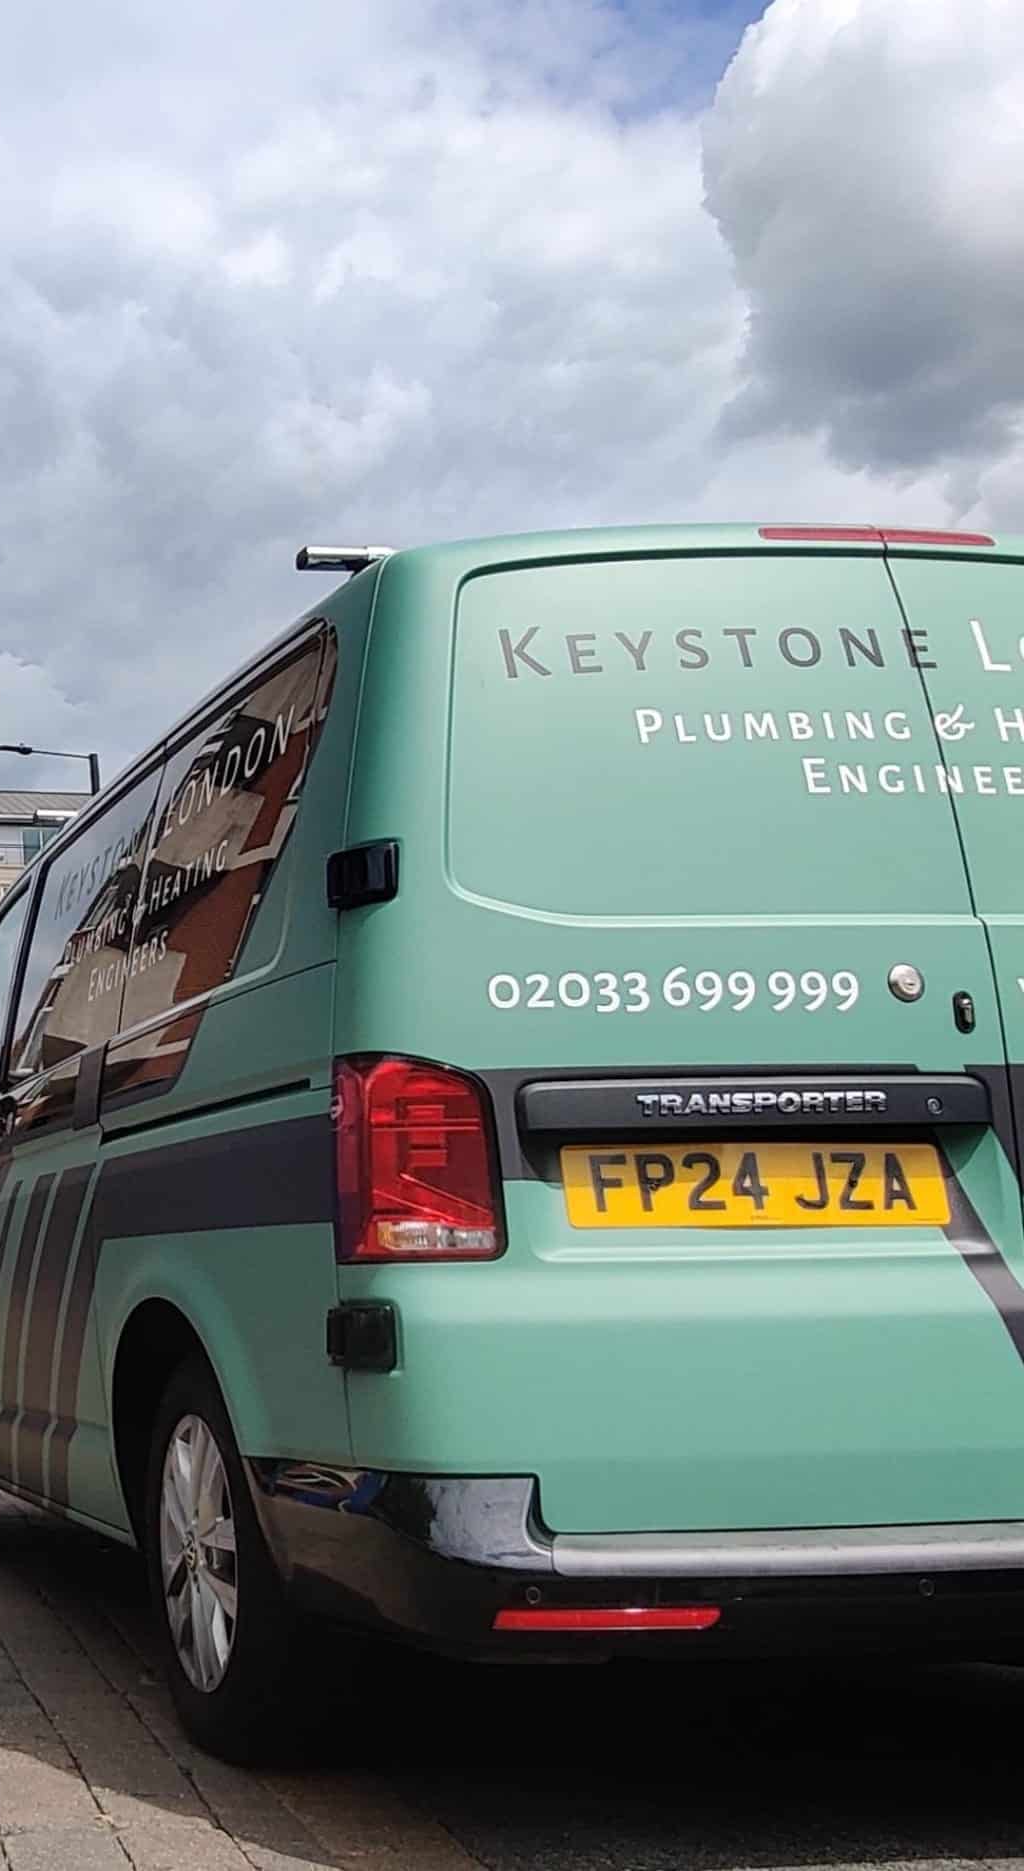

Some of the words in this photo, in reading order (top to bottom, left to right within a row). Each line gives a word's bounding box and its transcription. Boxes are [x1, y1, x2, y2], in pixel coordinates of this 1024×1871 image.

[497, 626, 939, 679] KEYSTONE
[969, 620, 1024, 671] L
[635, 708, 912, 743] PLUMBING
[934, 704, 975, 740] &
[163, 704, 295, 838] LONDON
[802, 758, 1024, 795] ENGINEE
[148, 839, 229, 916] HEATING
[88, 930, 169, 1002] ENGINEERS
[488, 972, 651, 1013] 02033
[662, 966, 756, 1012] 699
[767, 971, 860, 1012] 999
[637, 1091, 887, 1117] TRANSPORTER
[587, 1152, 769, 1213] FP24
[794, 1151, 918, 1212] JZA
